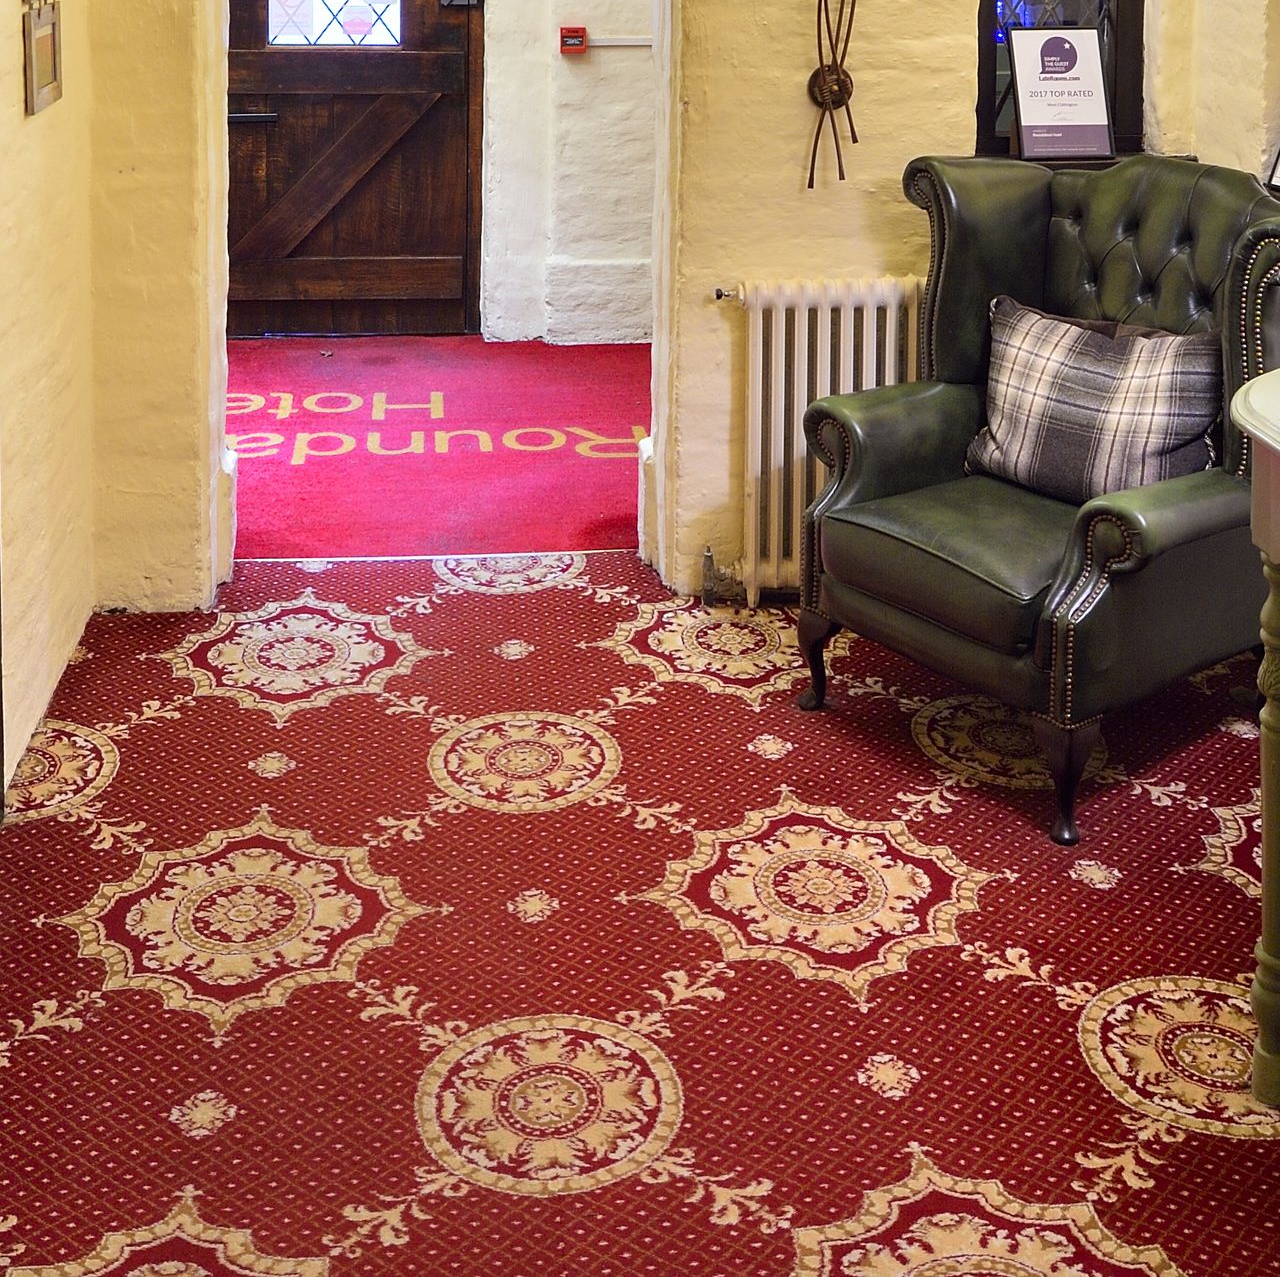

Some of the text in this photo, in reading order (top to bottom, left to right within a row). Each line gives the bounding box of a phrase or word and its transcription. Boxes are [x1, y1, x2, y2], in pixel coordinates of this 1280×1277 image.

[1029, 90, 1094, 98] 2017 TOP RATED
